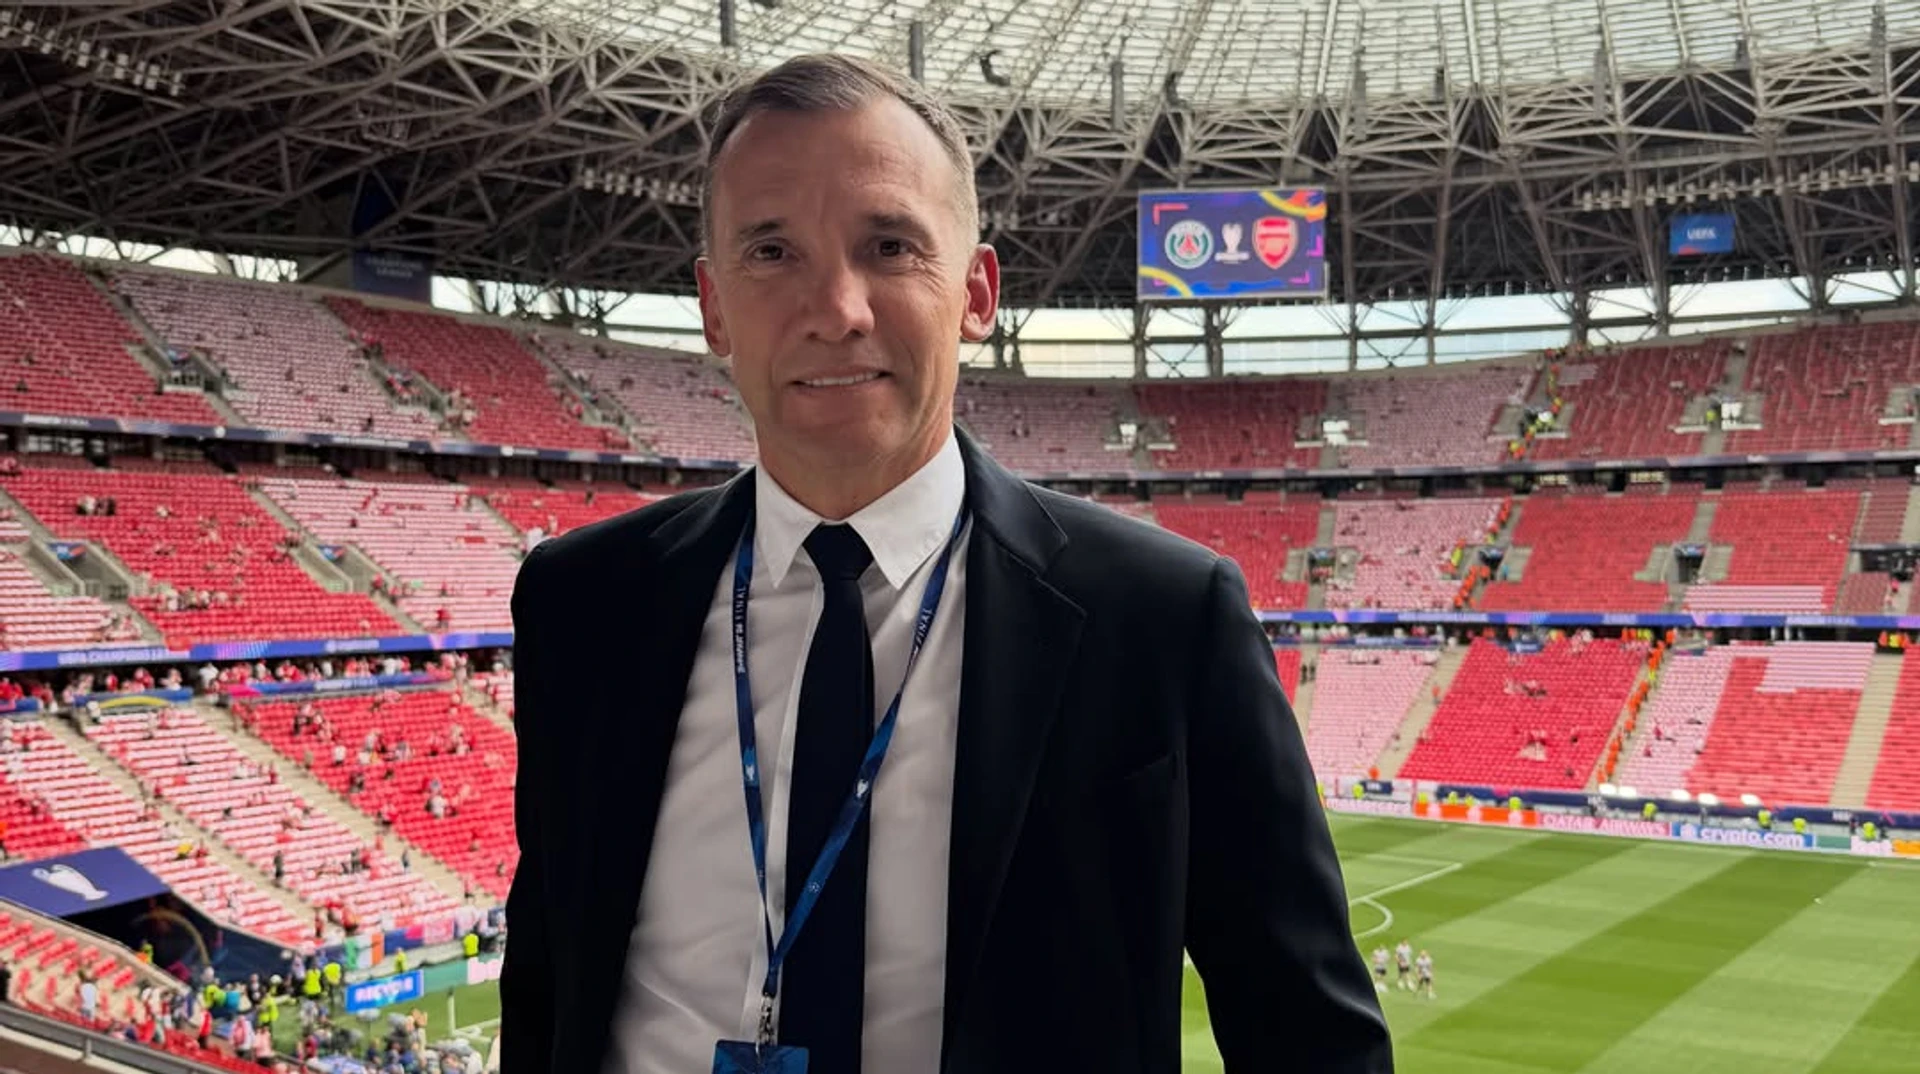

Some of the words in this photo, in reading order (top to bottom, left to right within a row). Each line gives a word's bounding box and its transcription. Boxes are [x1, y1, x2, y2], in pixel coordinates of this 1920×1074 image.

[1687, 227, 1717, 240] UEFA
[1543, 814, 1596, 833] QATAR
[1597, 818, 1666, 837] AIRWAYS
[1700, 827, 1805, 848] crypto.com
